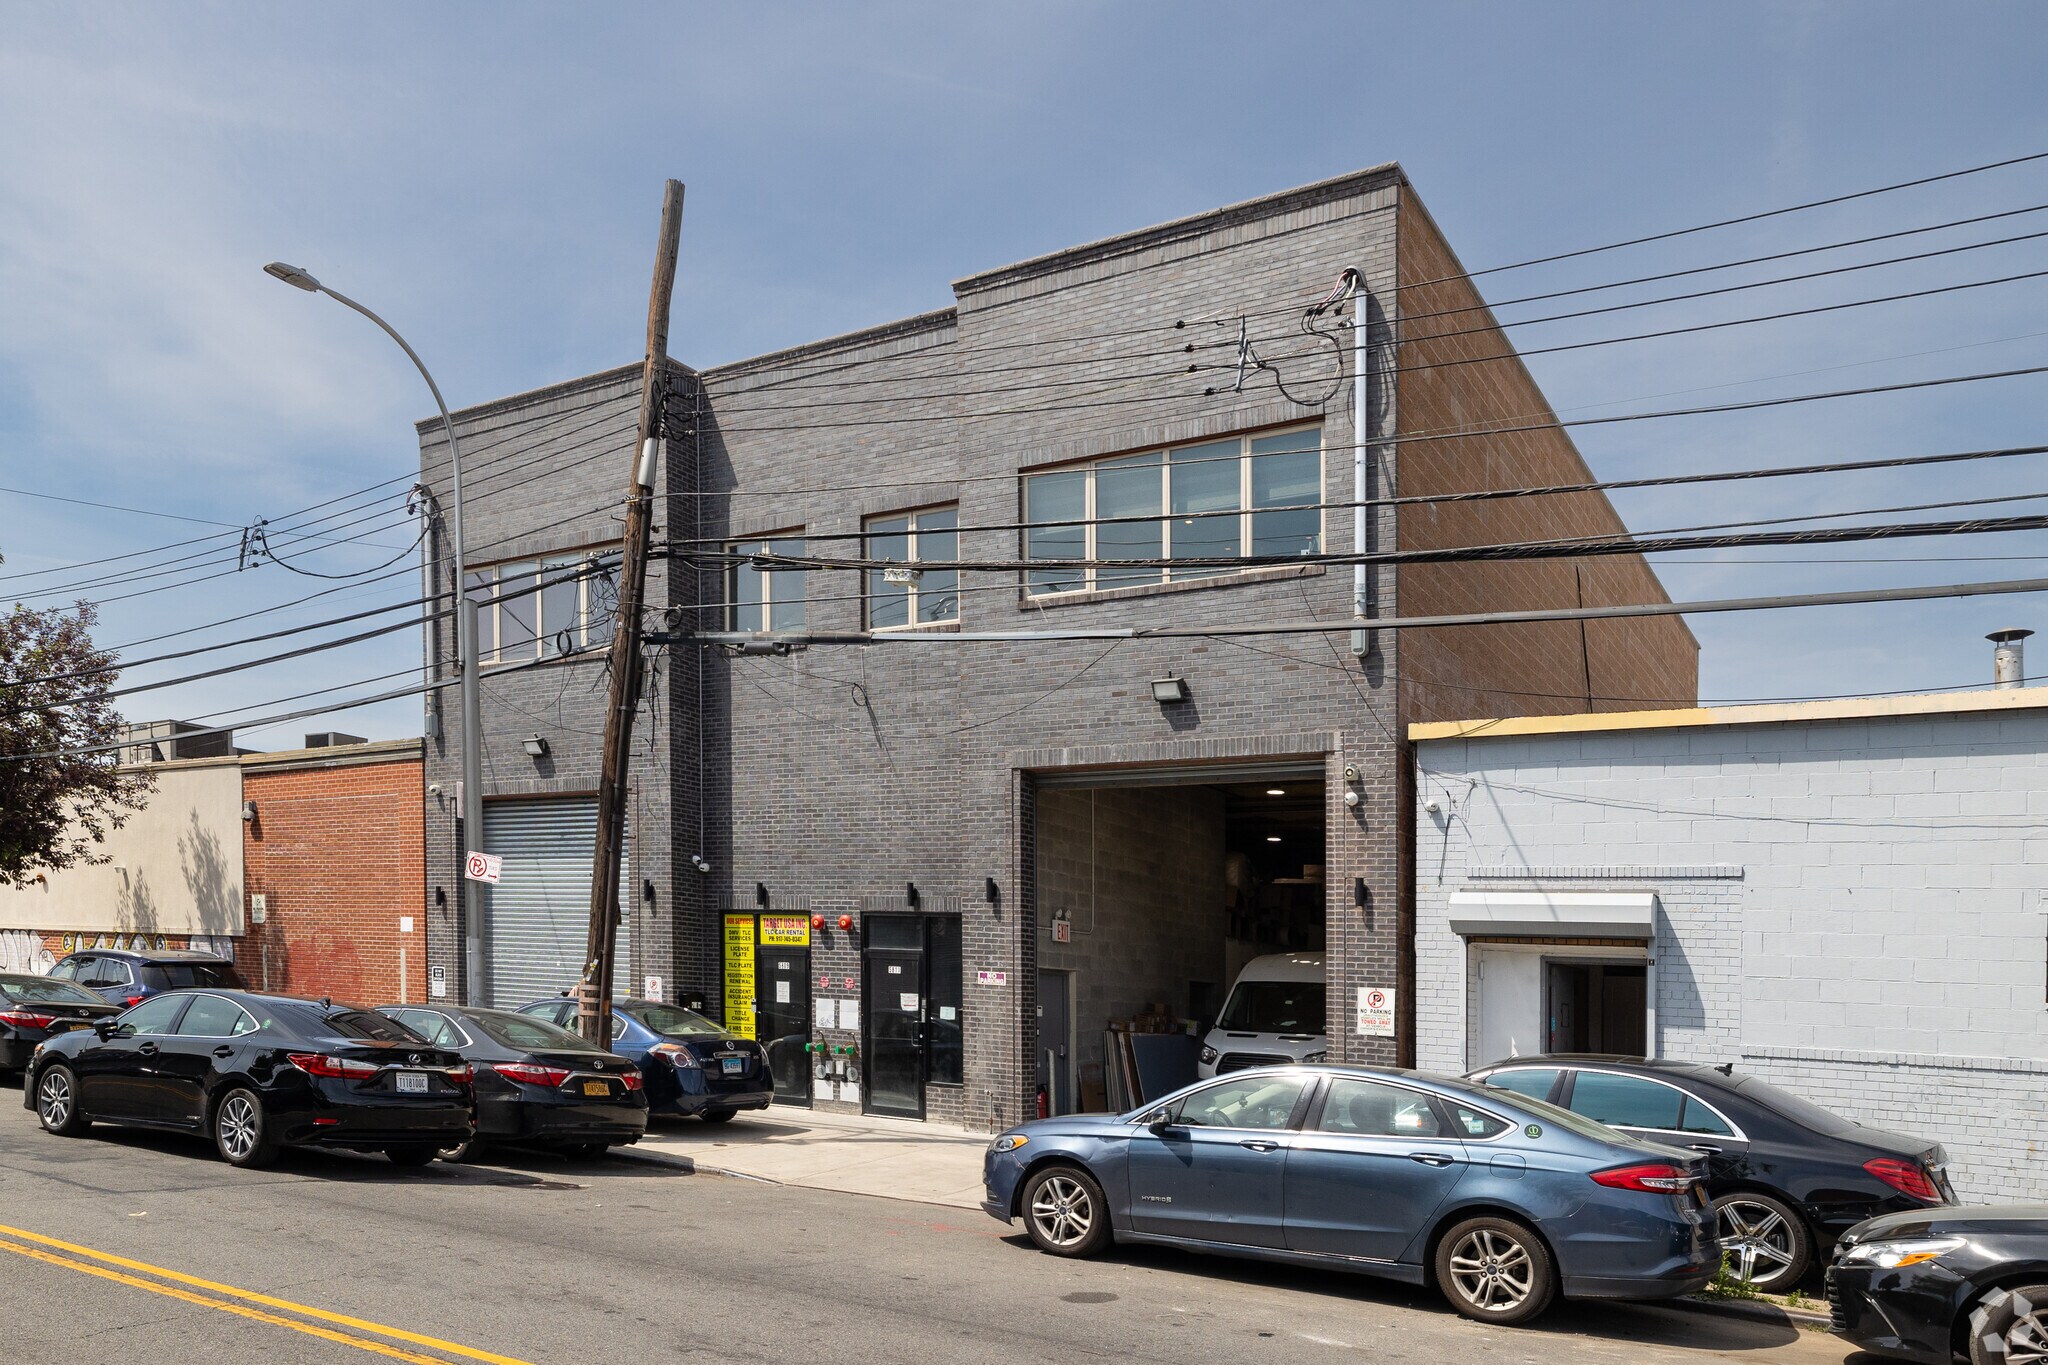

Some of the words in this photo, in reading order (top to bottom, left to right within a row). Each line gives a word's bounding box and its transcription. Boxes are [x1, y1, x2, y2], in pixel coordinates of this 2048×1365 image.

[763, 917, 783, 929] TARGET
[783, 917, 795, 929] USA
[1058, 923, 1069, 941] EXIT
